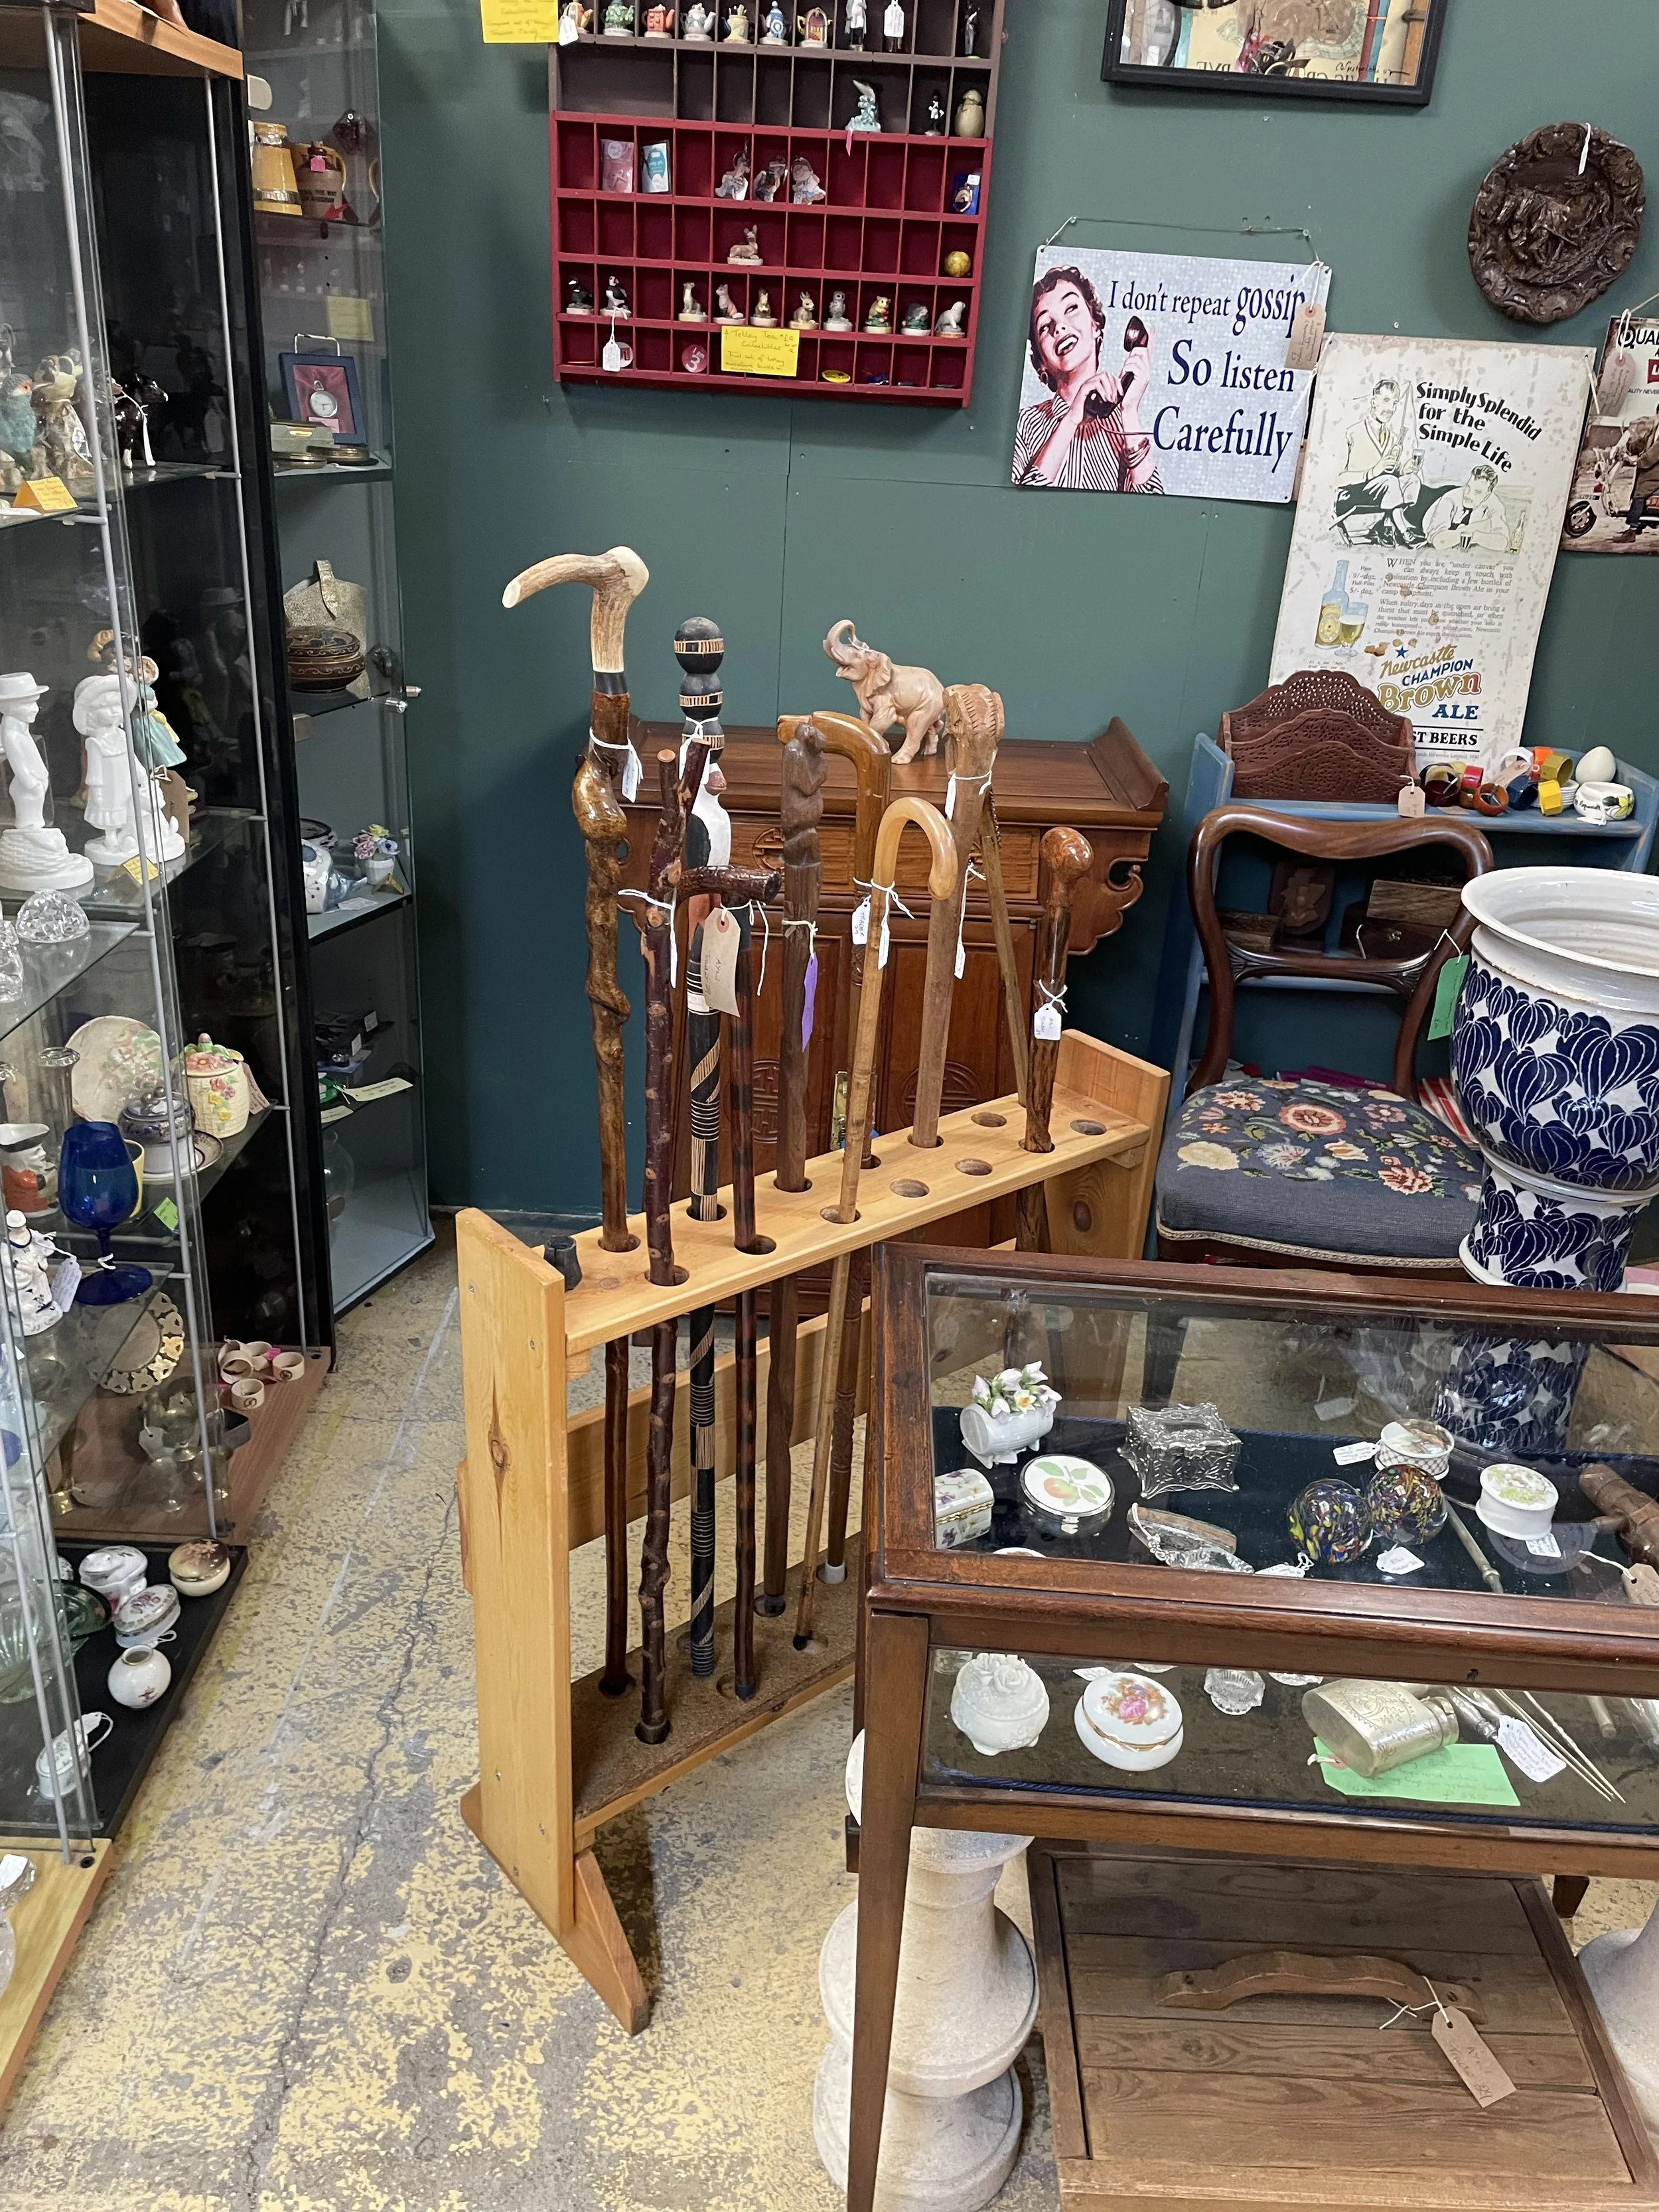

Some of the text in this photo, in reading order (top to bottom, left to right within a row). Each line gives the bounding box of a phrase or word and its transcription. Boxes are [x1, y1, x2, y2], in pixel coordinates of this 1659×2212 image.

[1108, 274, 1306, 338] I don't repeat gossip
[761, 330, 778, 340] Tea
[1167, 339, 1294, 392] So listen
[1416, 382, 1542, 441] Simply Splendid
[1419, 402, 1486, 431] for the
[1153, 406, 1293, 474] Carefully
[1419, 423, 1512, 473] Simple Life
[1417, 583, 1448, 591] Champion
[1430, 576, 1459, 585] including
[1380, 644, 1457, 678] Newcastle
[1402, 658, 1474, 686] CHAMPION
[1377, 672, 1482, 713] Brown
[1432, 704, 1479, 719] ALE
[1429, 732, 1478, 746] BEERS
